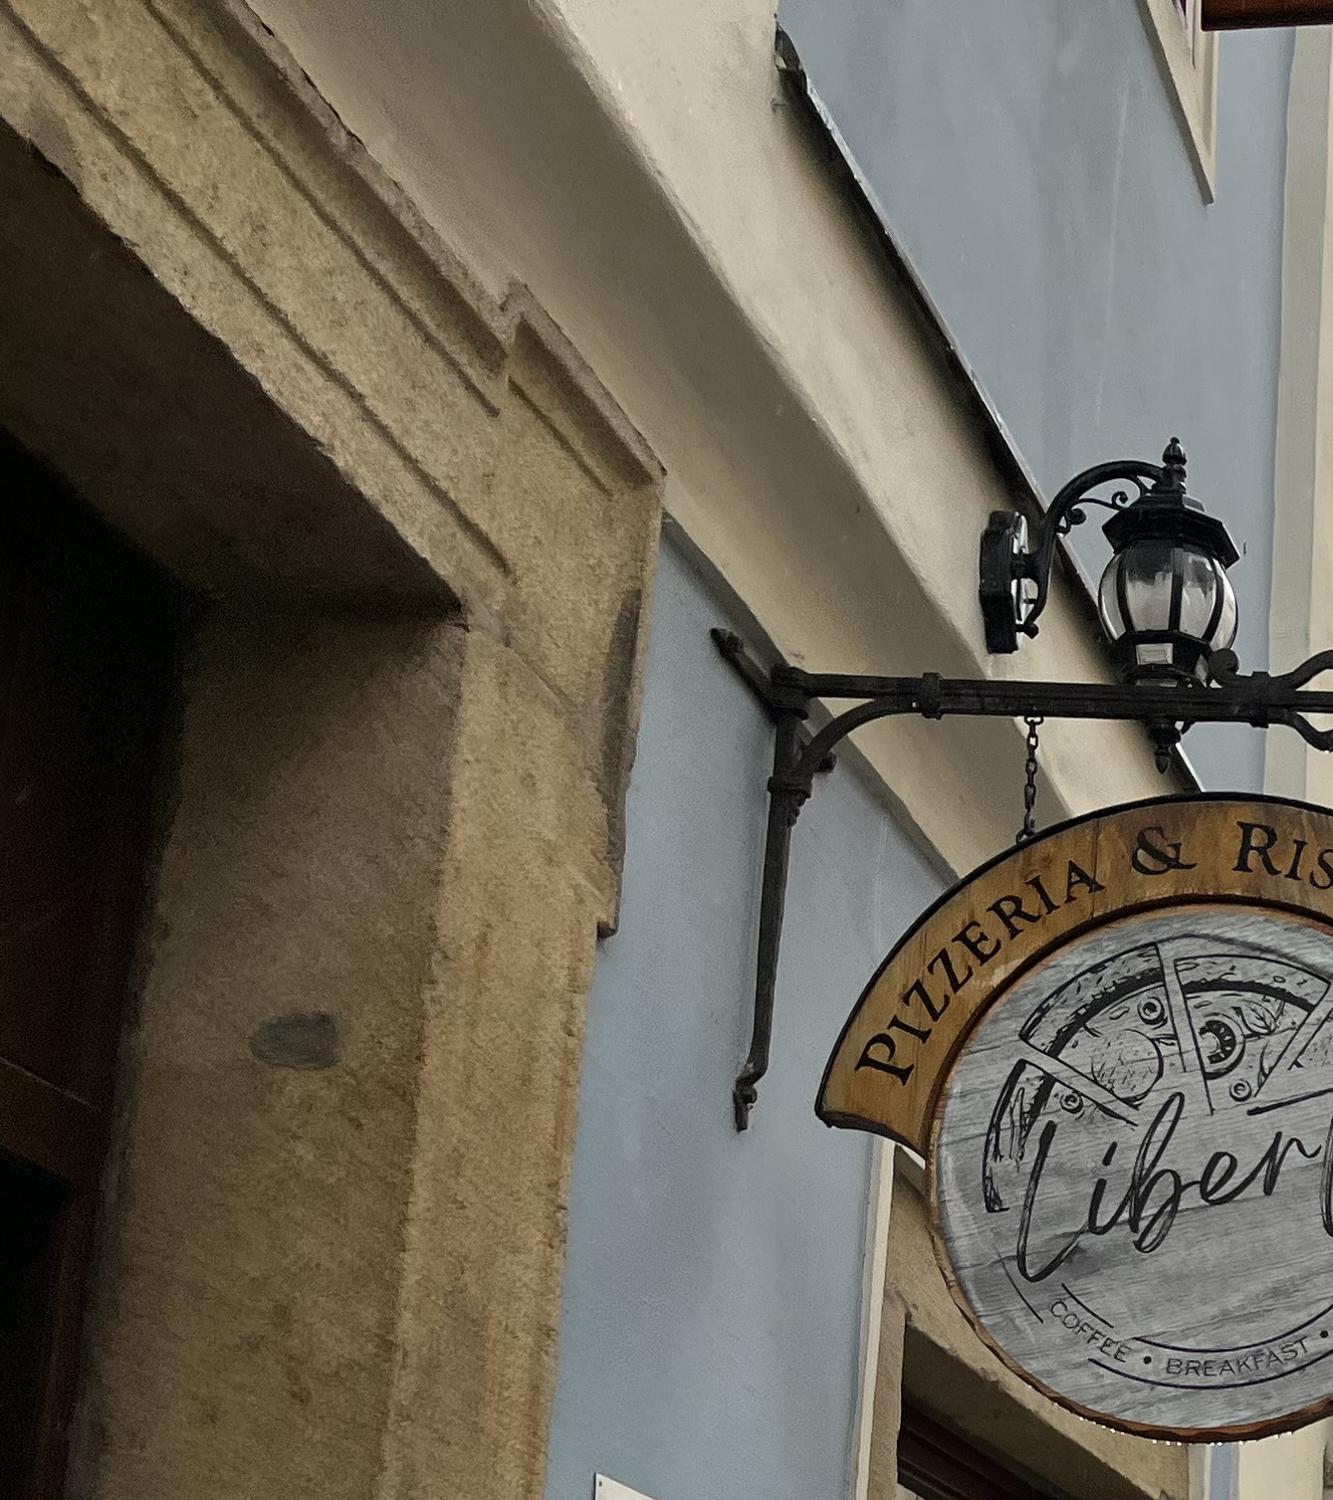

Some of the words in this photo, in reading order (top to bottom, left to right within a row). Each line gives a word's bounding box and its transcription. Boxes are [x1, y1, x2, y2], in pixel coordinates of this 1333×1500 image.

[854, 857, 1103, 1087] PIZZERIA
[1130, 825, 1197, 875] &
[1048, 1299, 1129, 1366] COFFEE
[1165, 1336, 1311, 1379] BREAKFAST
